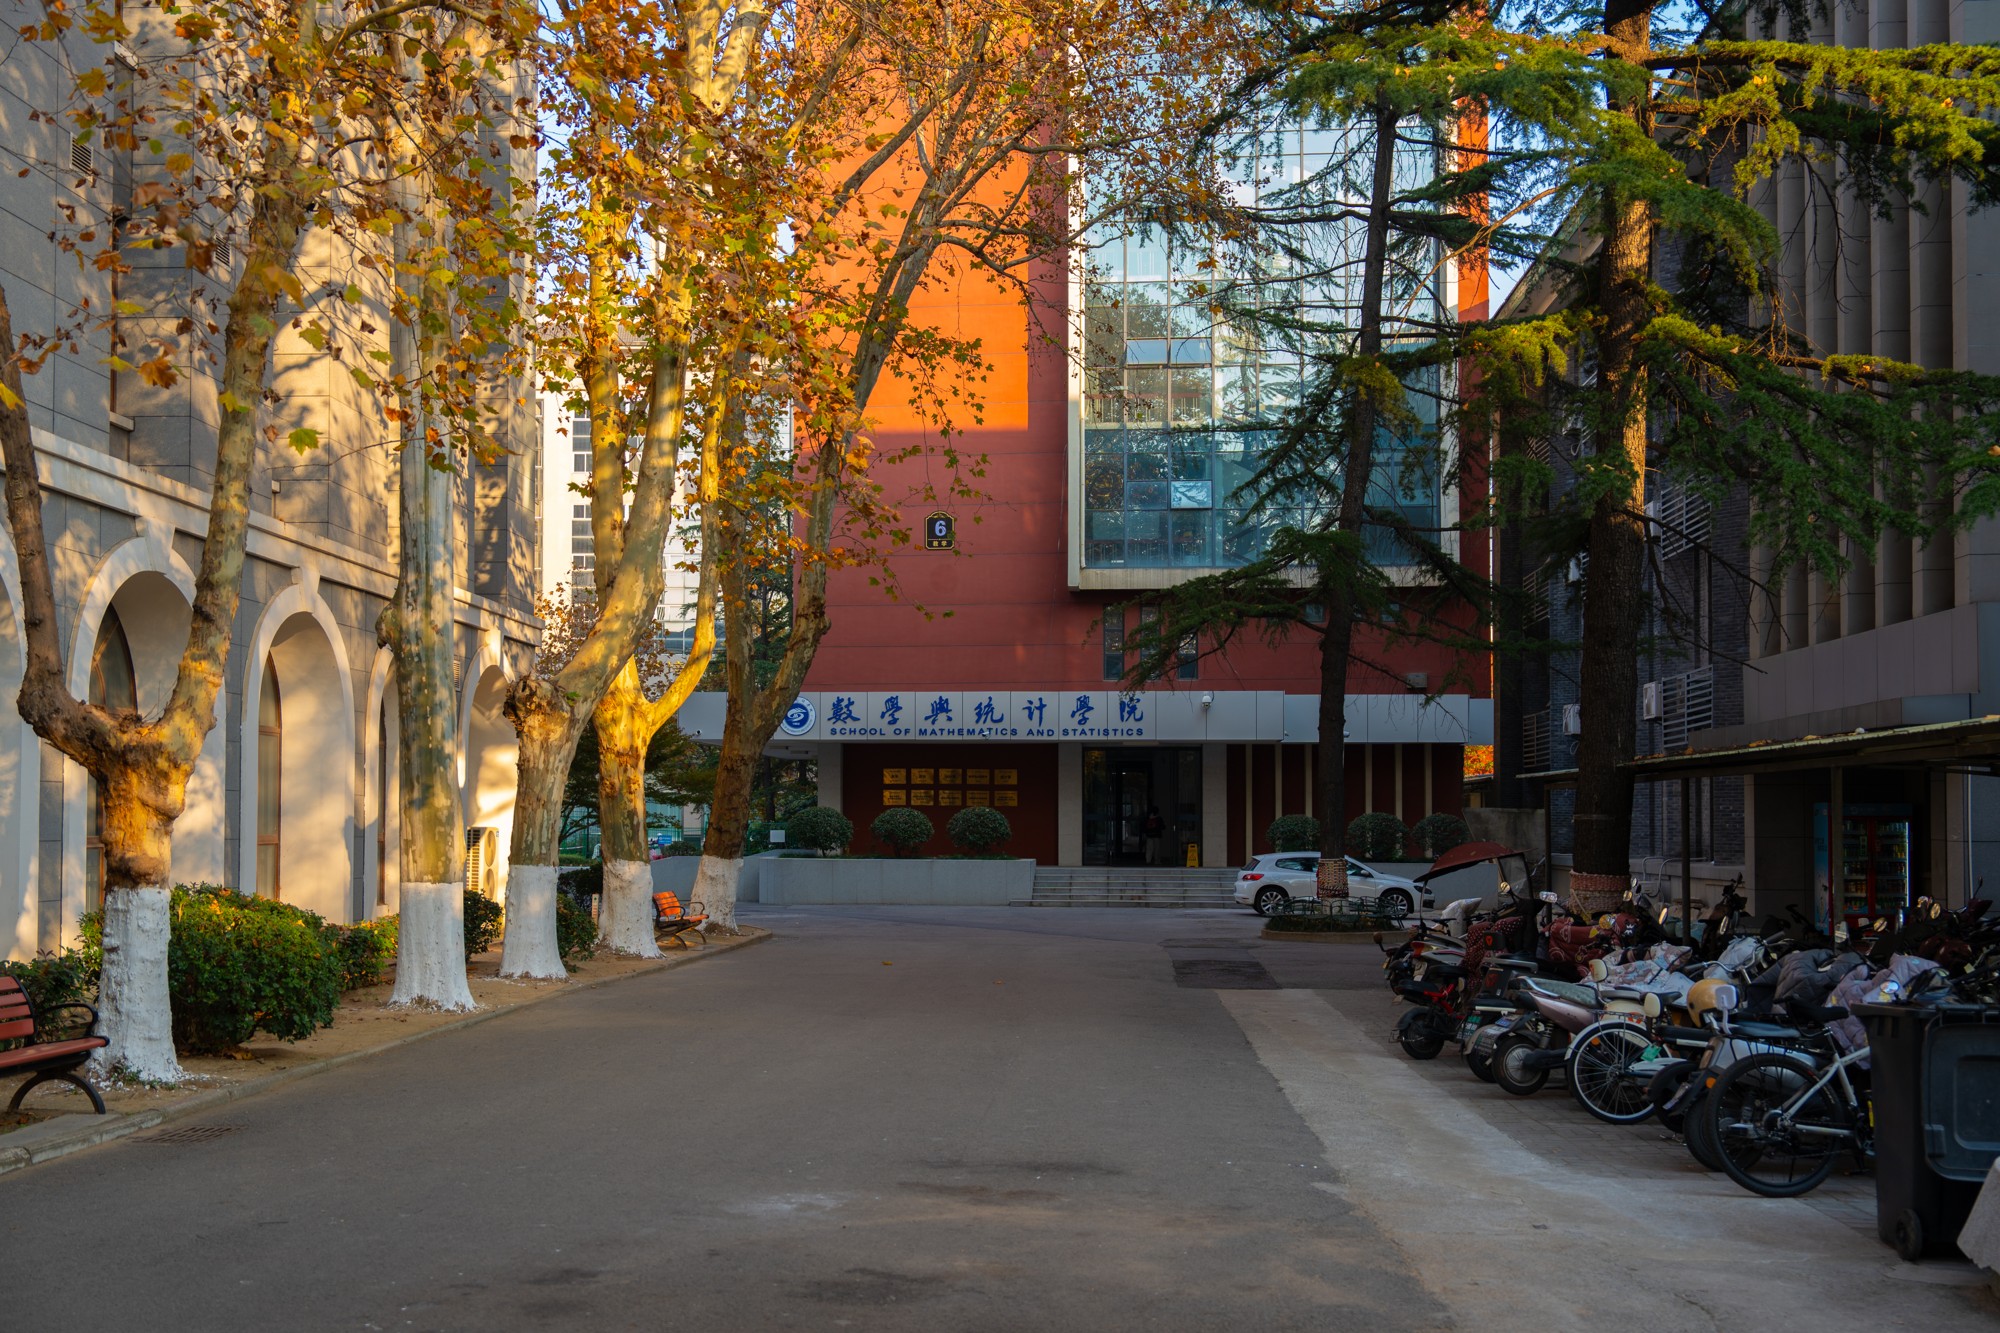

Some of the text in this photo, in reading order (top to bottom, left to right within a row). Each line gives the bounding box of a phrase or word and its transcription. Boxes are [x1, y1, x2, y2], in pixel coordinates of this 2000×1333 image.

[935, 520, 947, 537] 6
[830, 727, 1144, 737] SCHOOL OF MATHEMATICS AND STATISTICS
